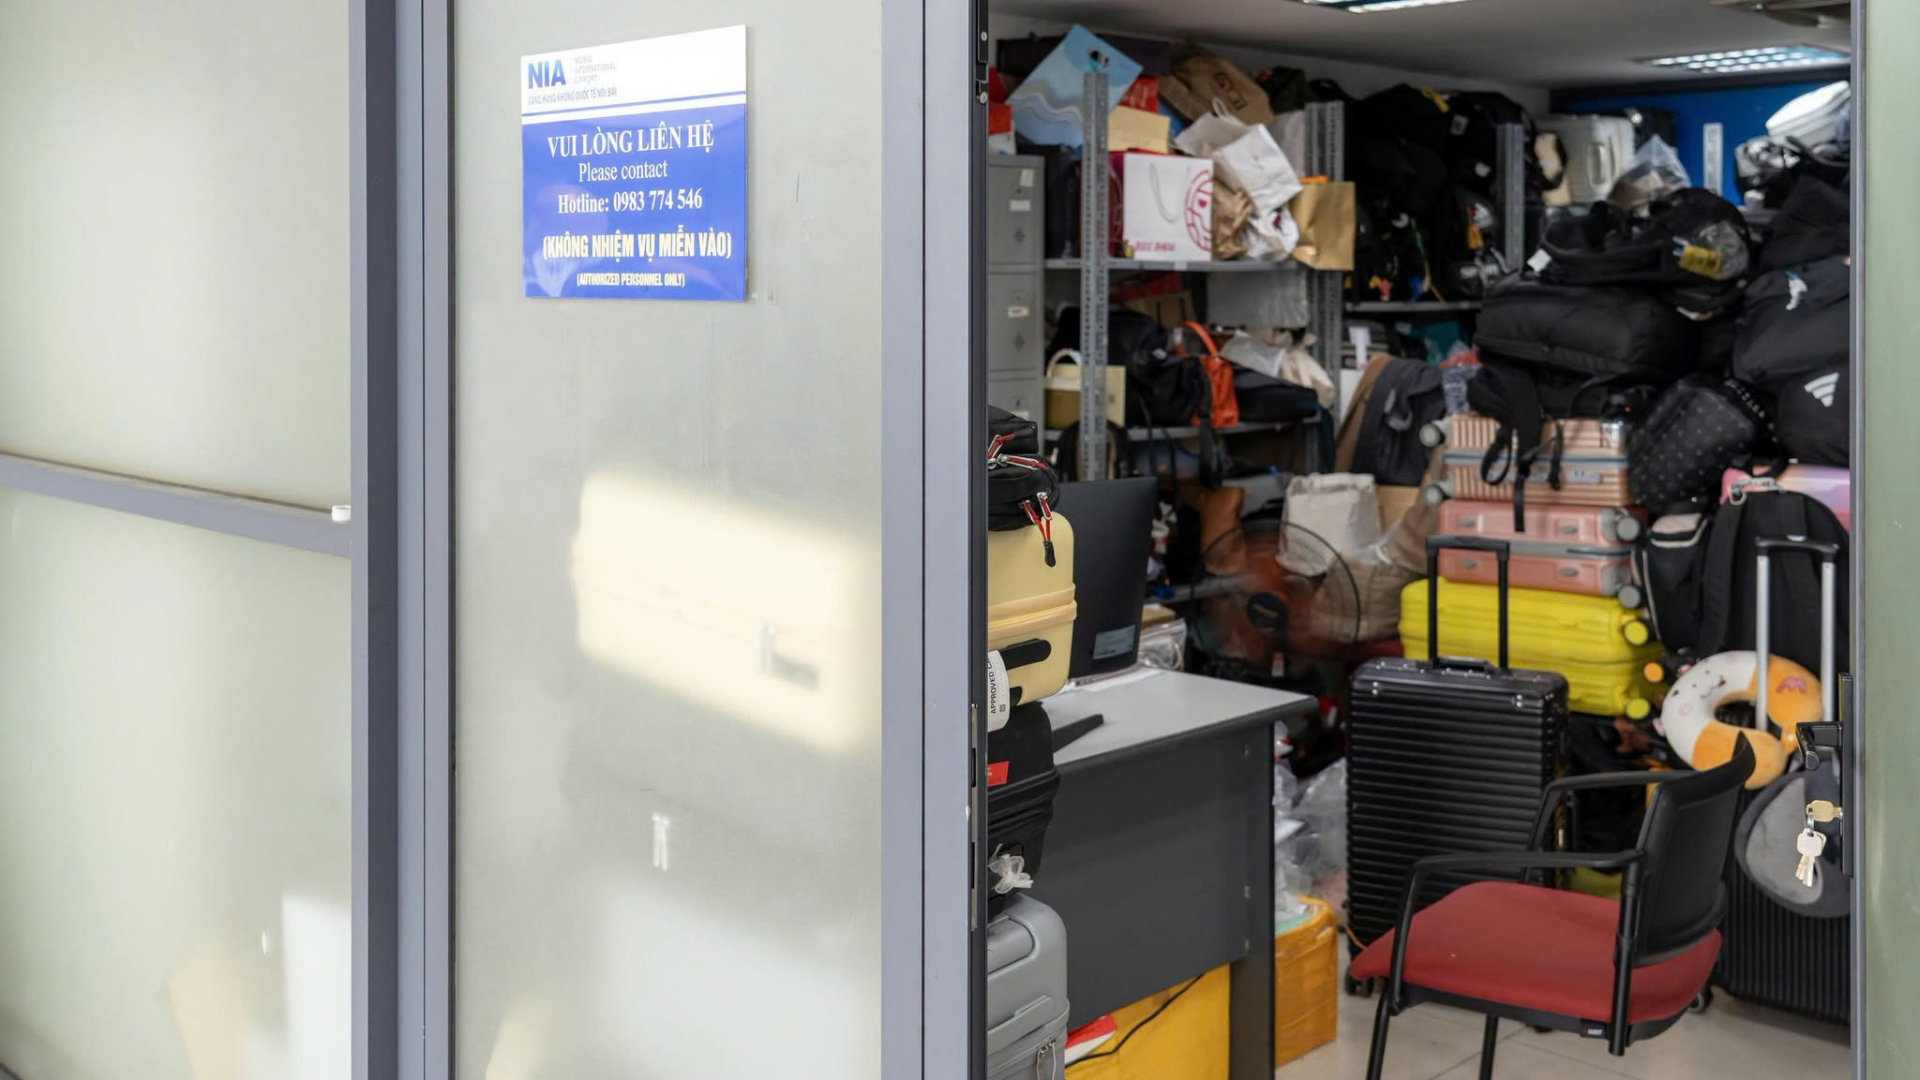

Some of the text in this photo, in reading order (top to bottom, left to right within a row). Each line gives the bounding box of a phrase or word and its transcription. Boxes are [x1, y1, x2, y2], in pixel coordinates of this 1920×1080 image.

[528, 59, 566, 89] NIA
[547, 119, 715, 158] VUI LÒNG LIÊN HỆ
[578, 160, 668, 183] Please contact
[558, 187, 703, 214] Hotline: 0983 774 546
[543, 224, 732, 263] (KHÔNG NHIỆM VỤ MIỄN VÀO)
[577, 272, 686, 288] (AUTHORIZED PERSONNEL ONLY)
[988, 671, 997, 714] APPROVED
